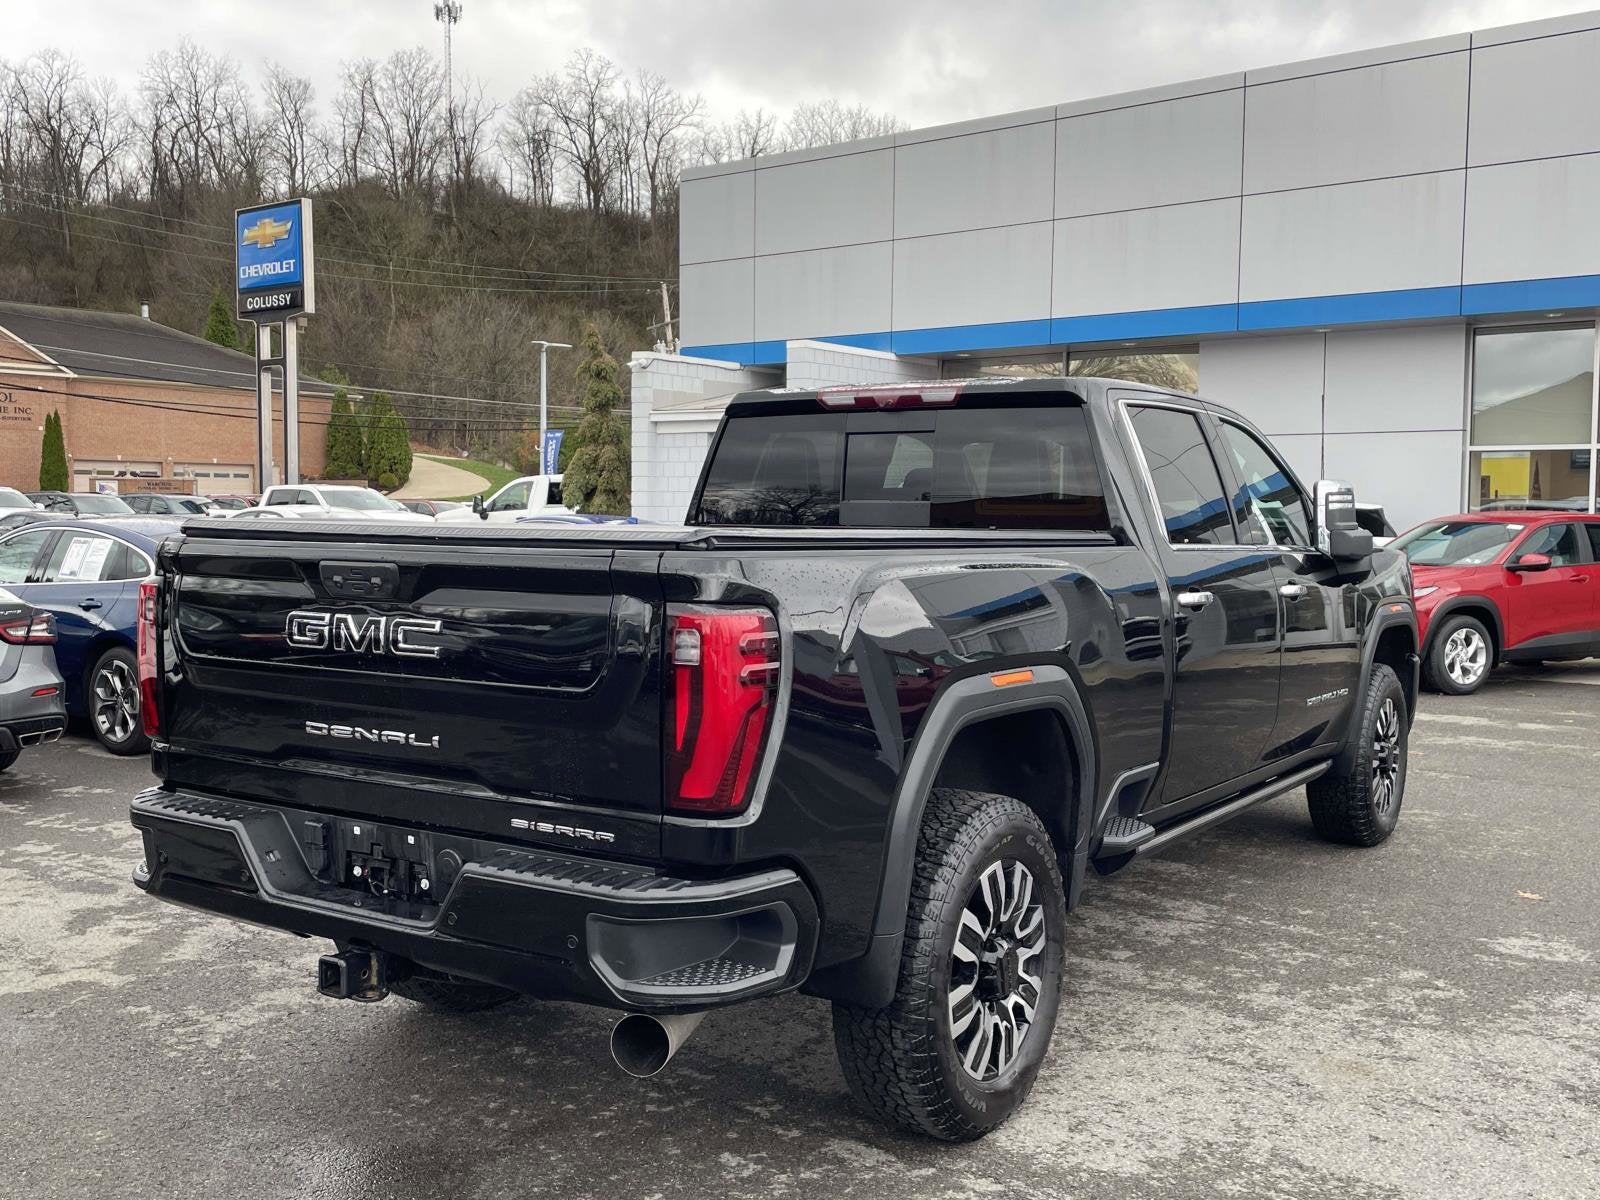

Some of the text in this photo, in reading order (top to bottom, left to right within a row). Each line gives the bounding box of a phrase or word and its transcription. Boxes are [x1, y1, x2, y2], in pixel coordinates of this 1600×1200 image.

[240, 259, 296, 278] CHEVROLET
[246, 293, 292, 309] COLUSSY
[285, 610, 443, 659] GMC
[305, 720, 440, 749] DENALI
[510, 818, 615, 842] SIERRA
